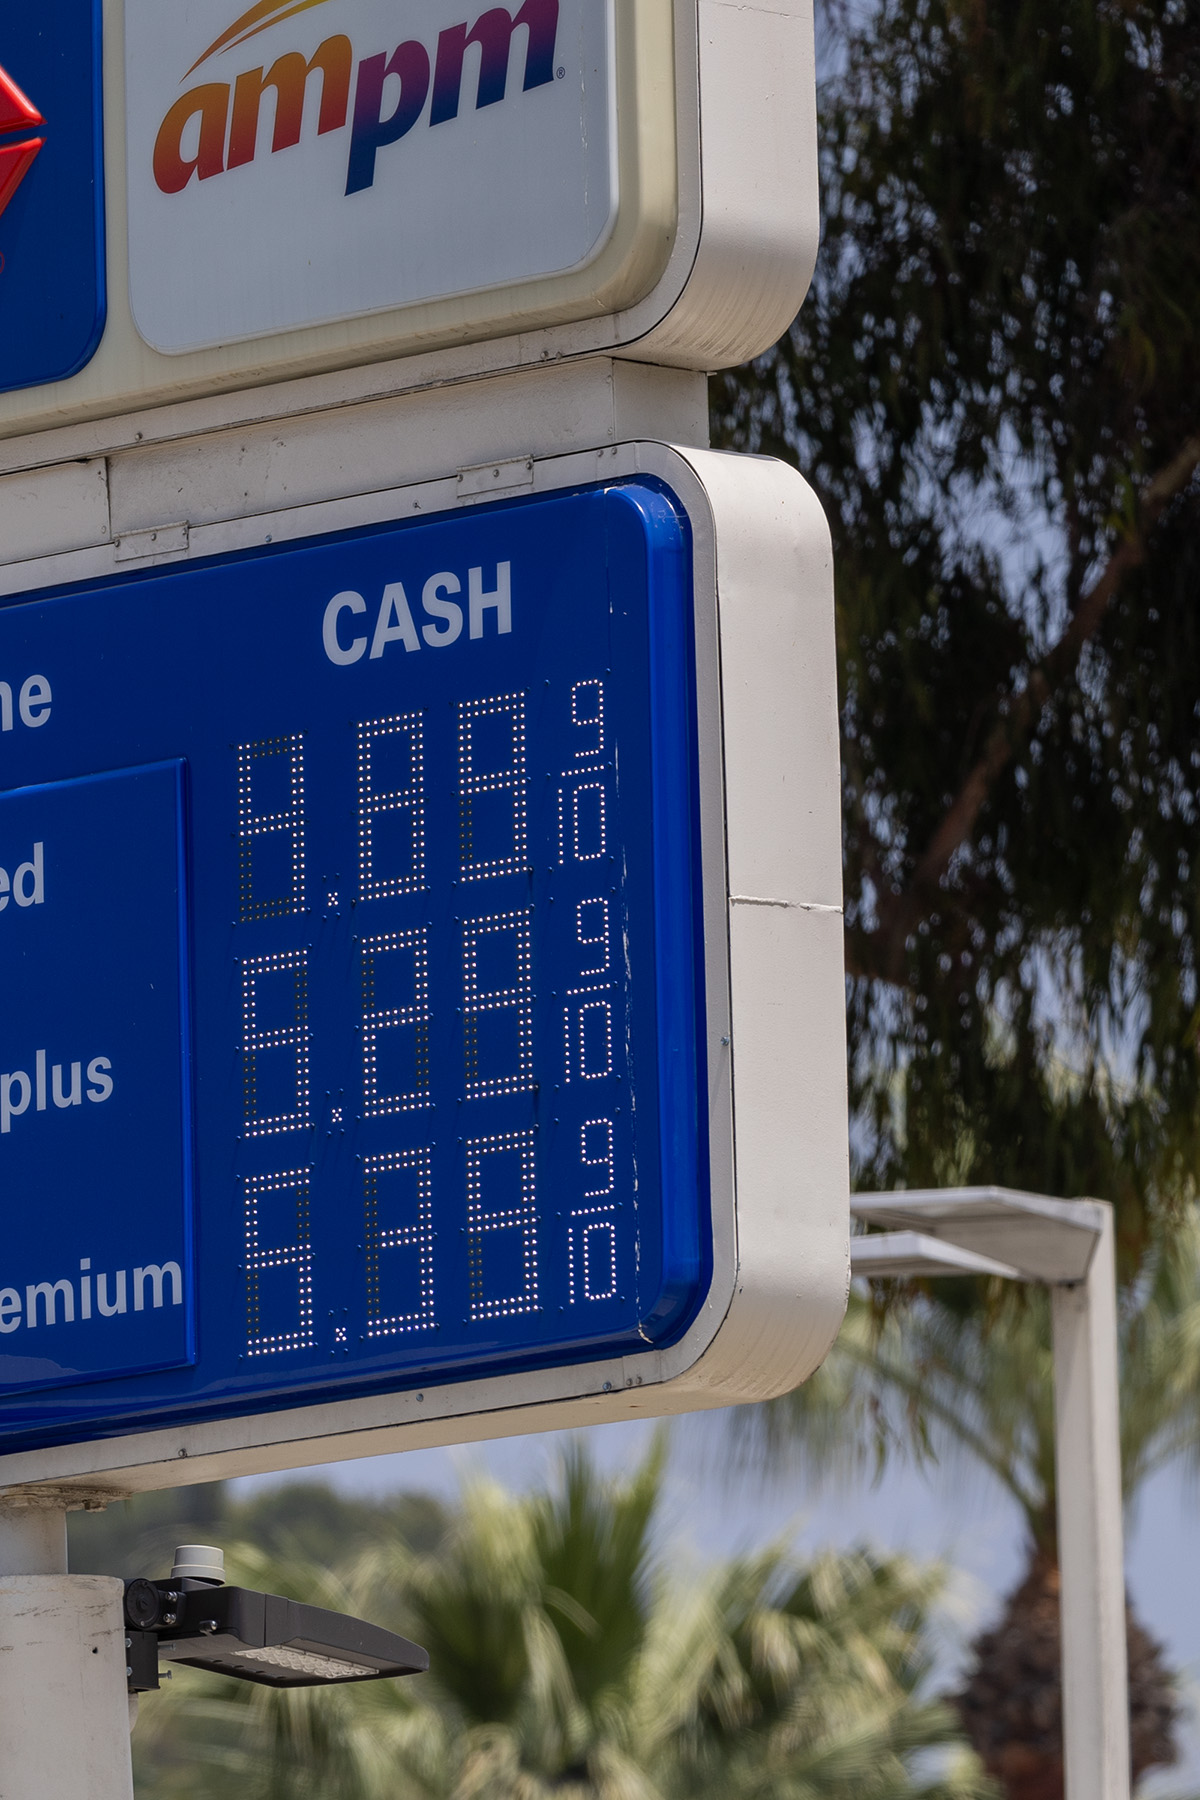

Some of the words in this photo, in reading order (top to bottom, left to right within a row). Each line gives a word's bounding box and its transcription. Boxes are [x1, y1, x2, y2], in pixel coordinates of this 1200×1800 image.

[153, 0, 557, 196] ampm
[323, 562, 511, 665] CASH
[239, 693, 526, 912] 4.89
[1, 1050, 113, 1133] plus
[244, 911, 532, 1136] 5.29
[246, 1131, 538, 1355] 5.39
